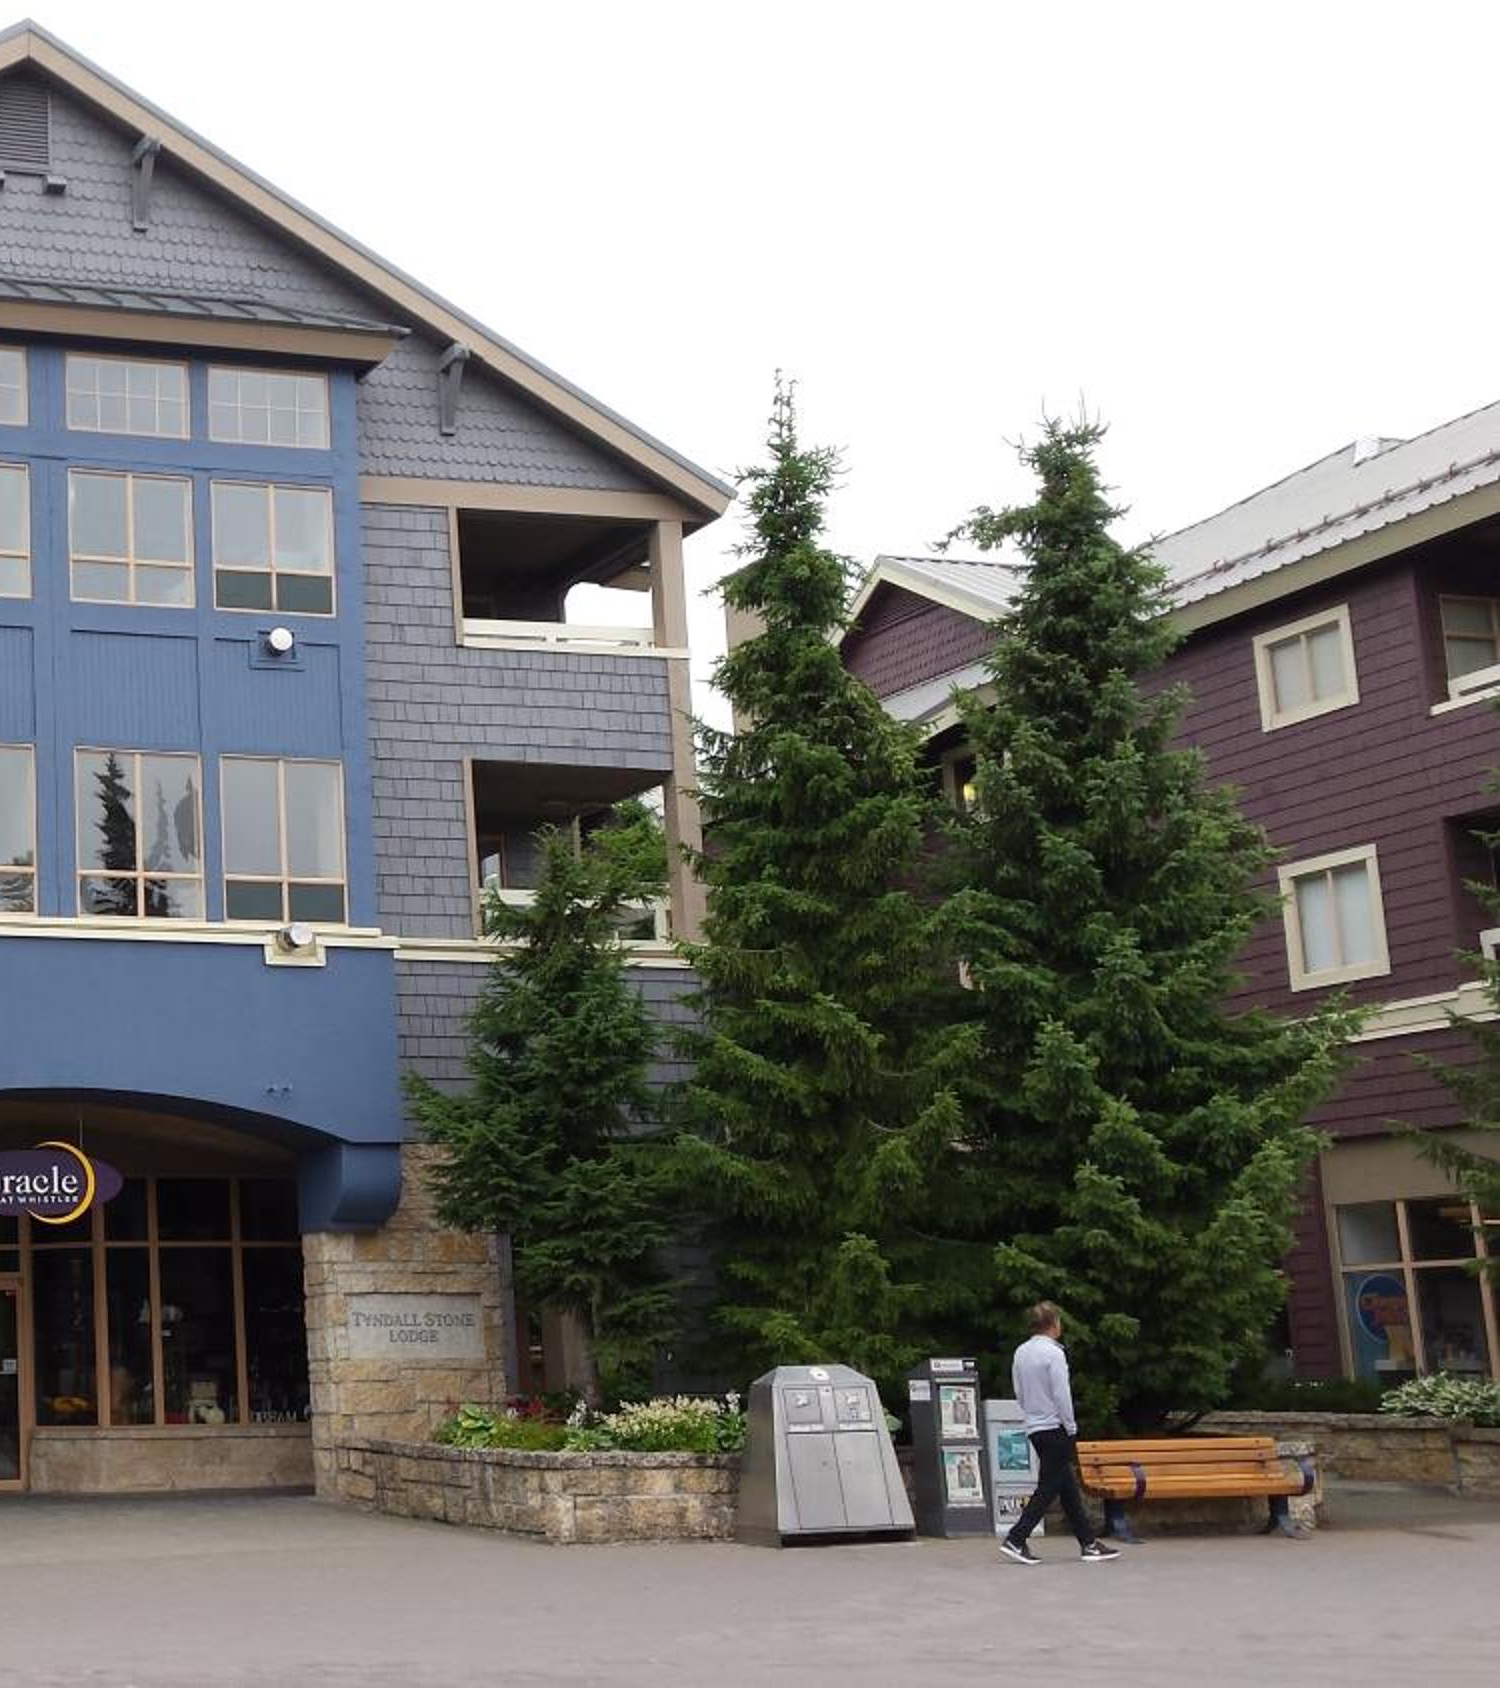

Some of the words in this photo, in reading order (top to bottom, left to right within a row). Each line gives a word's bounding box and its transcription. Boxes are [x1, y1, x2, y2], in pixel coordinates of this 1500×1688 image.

[0, 1195, 14, 1204] AT
[17, 1195, 79, 1204] WHISTLER
[352, 1312, 421, 1327] TYNDALL
[422, 1312, 476, 1327] STONE
[388, 1329, 439, 1343] LODGE
